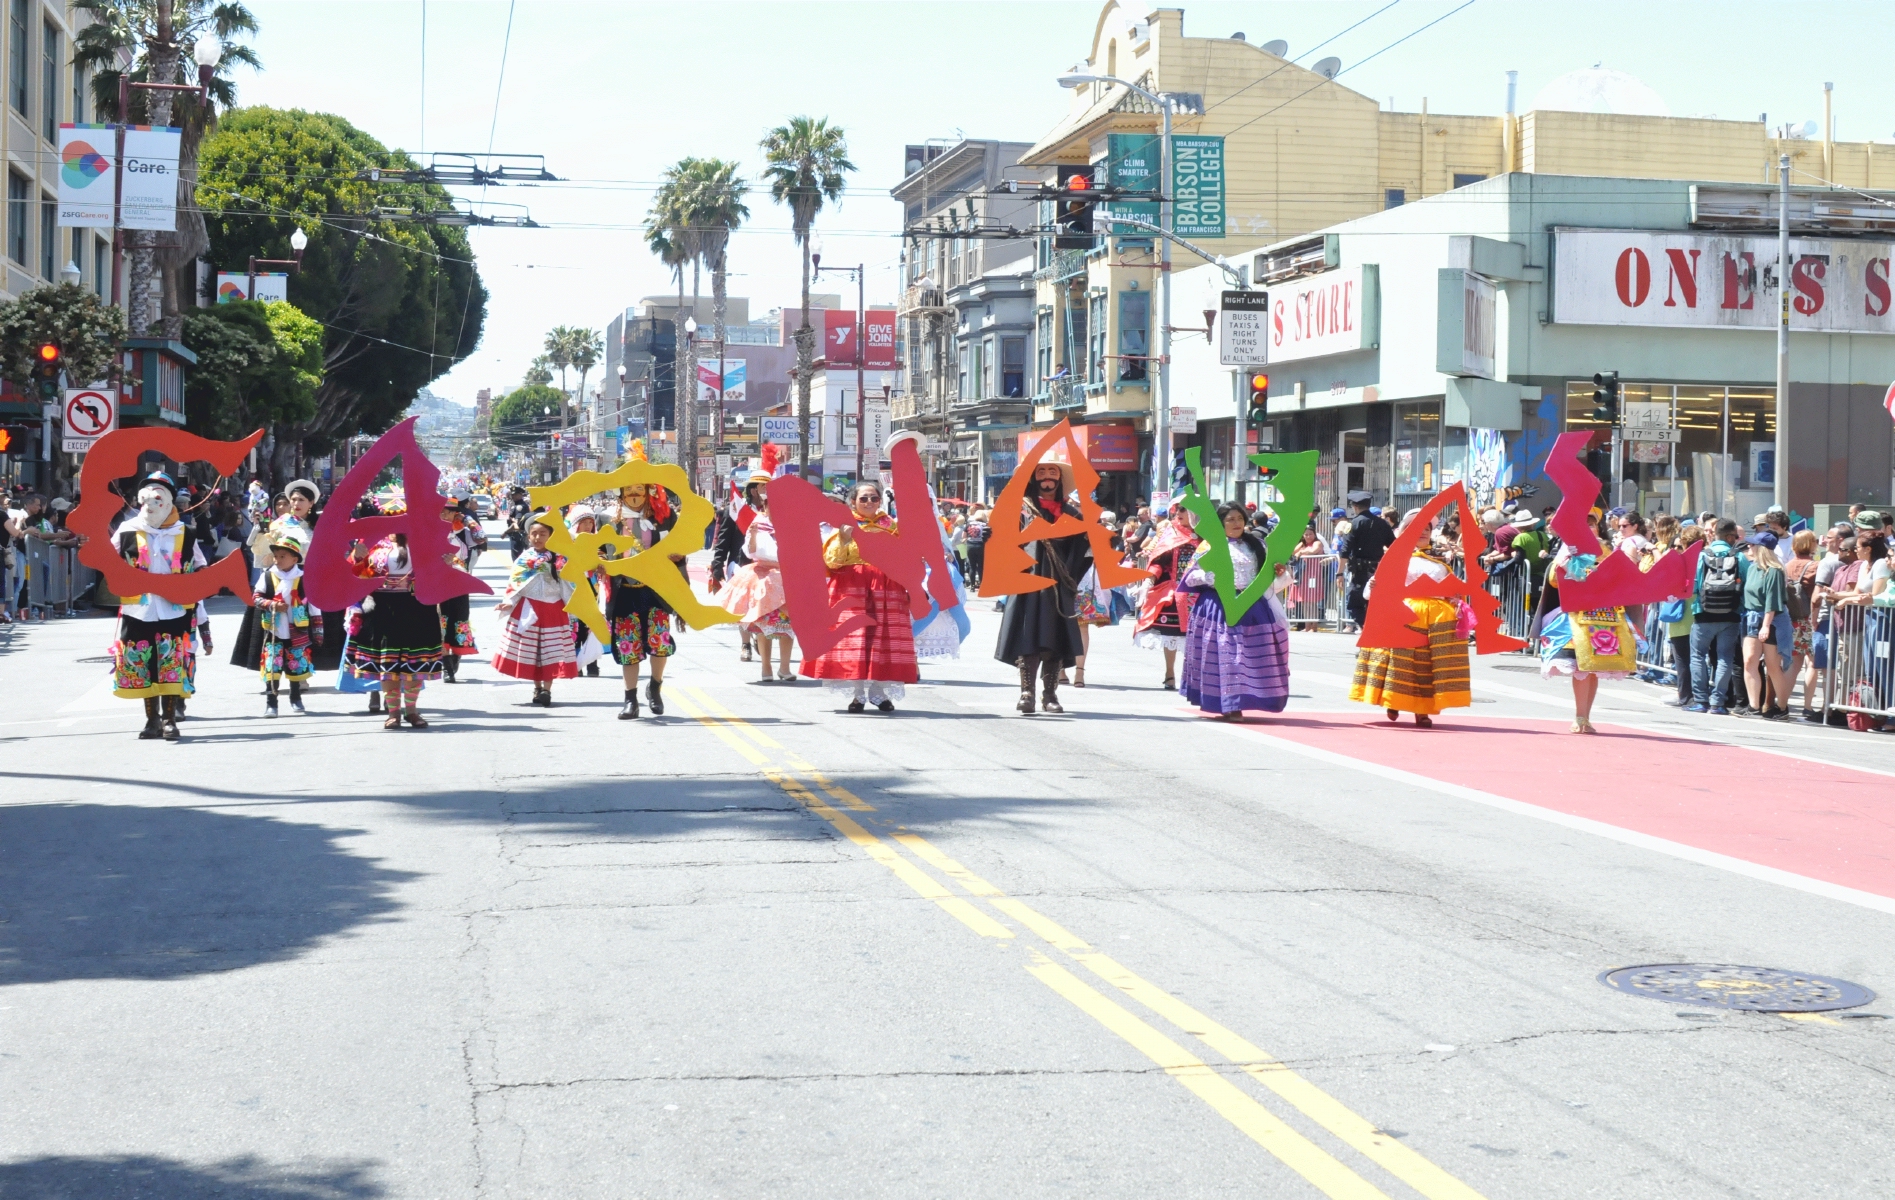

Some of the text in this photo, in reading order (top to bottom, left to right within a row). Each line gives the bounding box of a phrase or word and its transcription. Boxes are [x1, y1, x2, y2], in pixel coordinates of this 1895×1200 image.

[127, 159, 169, 175] Care.
[1124, 159, 1145, 167] CLIMB
[1118, 169, 1151, 177] SMARTER.
[1176, 147, 1199, 225] BABSON
[1200, 148, 1221, 225] COLLEGE
[61, 211, 109, 220] ZSFGCare.org
[1247, 297, 1265, 305] LANE
[1295, 280, 1353, 342] STORE
[1232, 313, 1258, 321] BUSES
[868, 324, 892, 334] GIVE
[1254, 322, 1260, 330] &
[868, 333, 892, 343] JOIN
[1246, 355, 1265, 363] TIMES
[1631, 430, 1672, 440] 17TH ST
[67, 441, 91, 450] EXCEPT
